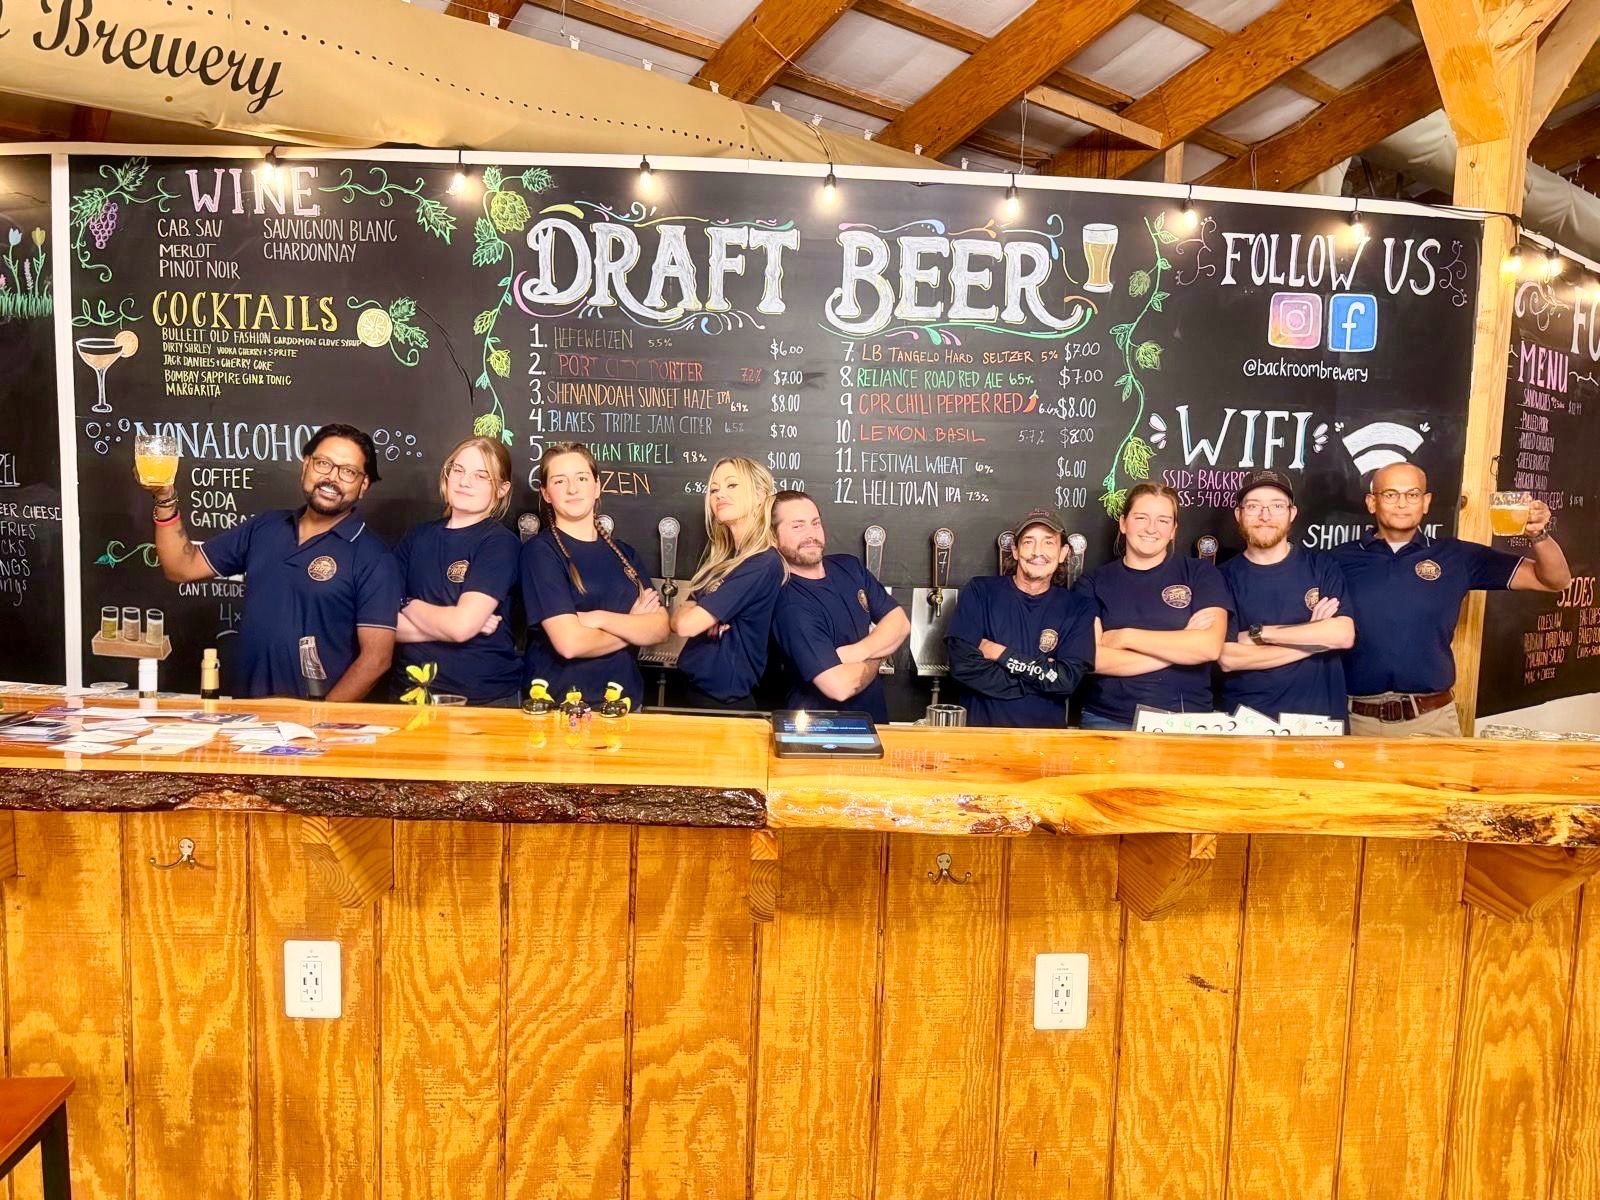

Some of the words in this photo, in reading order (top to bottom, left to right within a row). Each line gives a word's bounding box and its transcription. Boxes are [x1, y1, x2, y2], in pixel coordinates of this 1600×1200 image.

[33, 0, 283, 113] Brewery
[185, 166, 321, 217] WINE
[263, 218, 344, 241] SAUVIGNON
[350, 219, 398, 242] BLANC
[159, 243, 216, 259] MERLOT
[263, 242, 357, 263] CHARDONNAY
[1221, 231, 1372, 291] FOLLOW
[1383, 236, 1441, 296] US
[159, 259, 203, 278] PINOT
[206, 261, 241, 280] NOIR
[522, 217, 800, 320] DRAFT
[825, 230, 1083, 334] BEER
[152, 289, 339, 332] COCKTAILS
[162, 342, 183, 354] DIRTY
[268, 348, 298, 358] SPRITE
[209, 329, 234, 343] OLD
[234, 331, 271, 345] FASHION
[529, 323, 548, 348] 1.
[554, 326, 634, 351] HEFEWEIZEN
[162, 354, 181, 366] JACK
[183, 356, 215, 368] DANIELS
[221, 358, 251, 369] CHERRY
[253, 359, 275, 372] COKE
[841, 341, 855, 362] 7.
[862, 343, 882, 361] LB
[888, 347, 940, 364] TANGELO
[945, 349, 974, 364] HARD
[983, 350, 1034, 365] SELTZER
[1041, 350, 1058, 363] 5%
[1064, 341, 1100, 363] $7.00
[164, 369, 199, 383] BOMBAY
[266, 374, 292, 386] TONIC
[528, 352, 546, 375] 2.
[559, 354, 600, 377] PORT
[648, 359, 703, 383] PORTER
[773, 369, 803, 386] $7.00
[840, 365, 854, 387] 8.
[857, 367, 918, 389] RELIANCE
[924, 369, 956, 390] ROAD
[958, 369, 980, 389] RED
[983, 371, 1004, 389] ALE
[1058, 365, 1103, 389] $7.00
[1242, 357, 1369, 383] @backroombrewery
[1517, 340, 1569, 393] MENU
[165, 382, 221, 398] MARGARITA
[529, 378, 545, 405] 3.
[547, 381, 636, 408] SHENANDOAH
[638, 385, 680, 409] SUNSET
[683, 388, 715, 410] HAZE
[770, 393, 800, 413] $8.00
[858, 393, 894, 415] CPR
[896, 392, 932, 415] CHILI
[937, 392, 990, 414] PEPPER
[993, 392, 1023, 414] RED
[1057, 396, 1097, 420] $8.00
[528, 407, 546, 433] 4.
[547, 409, 595, 433] BLAKES
[601, 412, 642, 433] TRIPLE
[647, 414, 676, 434] JAM
[770, 422, 798, 439] $7.00
[835, 418, 856, 444] 10.
[860, 424, 928, 443] LEMON
[934, 426, 986, 443] BASIL
[1176, 405, 1313, 469] WIFI
[626, 442, 674, 465] TRIPEL
[767, 450, 801, 471] $10.00
[834, 447, 857, 473] 11.
[861, 451, 922, 474] FESTIVAL
[925, 455, 968, 475] WHEAT
[975, 461, 994, 474] 6%
[1056, 456, 1087, 480] $6.00
[191, 467, 255, 489] COFFEE
[191, 490, 237, 511] SODA
[834, 477, 858, 504] 12.
[862, 478, 939, 507] HELLTOWN
[945, 486, 961, 502] IPA
[1054, 486, 1087, 509] $8.00
[0, 520, 36, 540] FRIES
[191, 510, 255, 529] GATOR
[178, 582, 208, 598] CAN'T
[1556, 576, 1595, 608] SIDES
